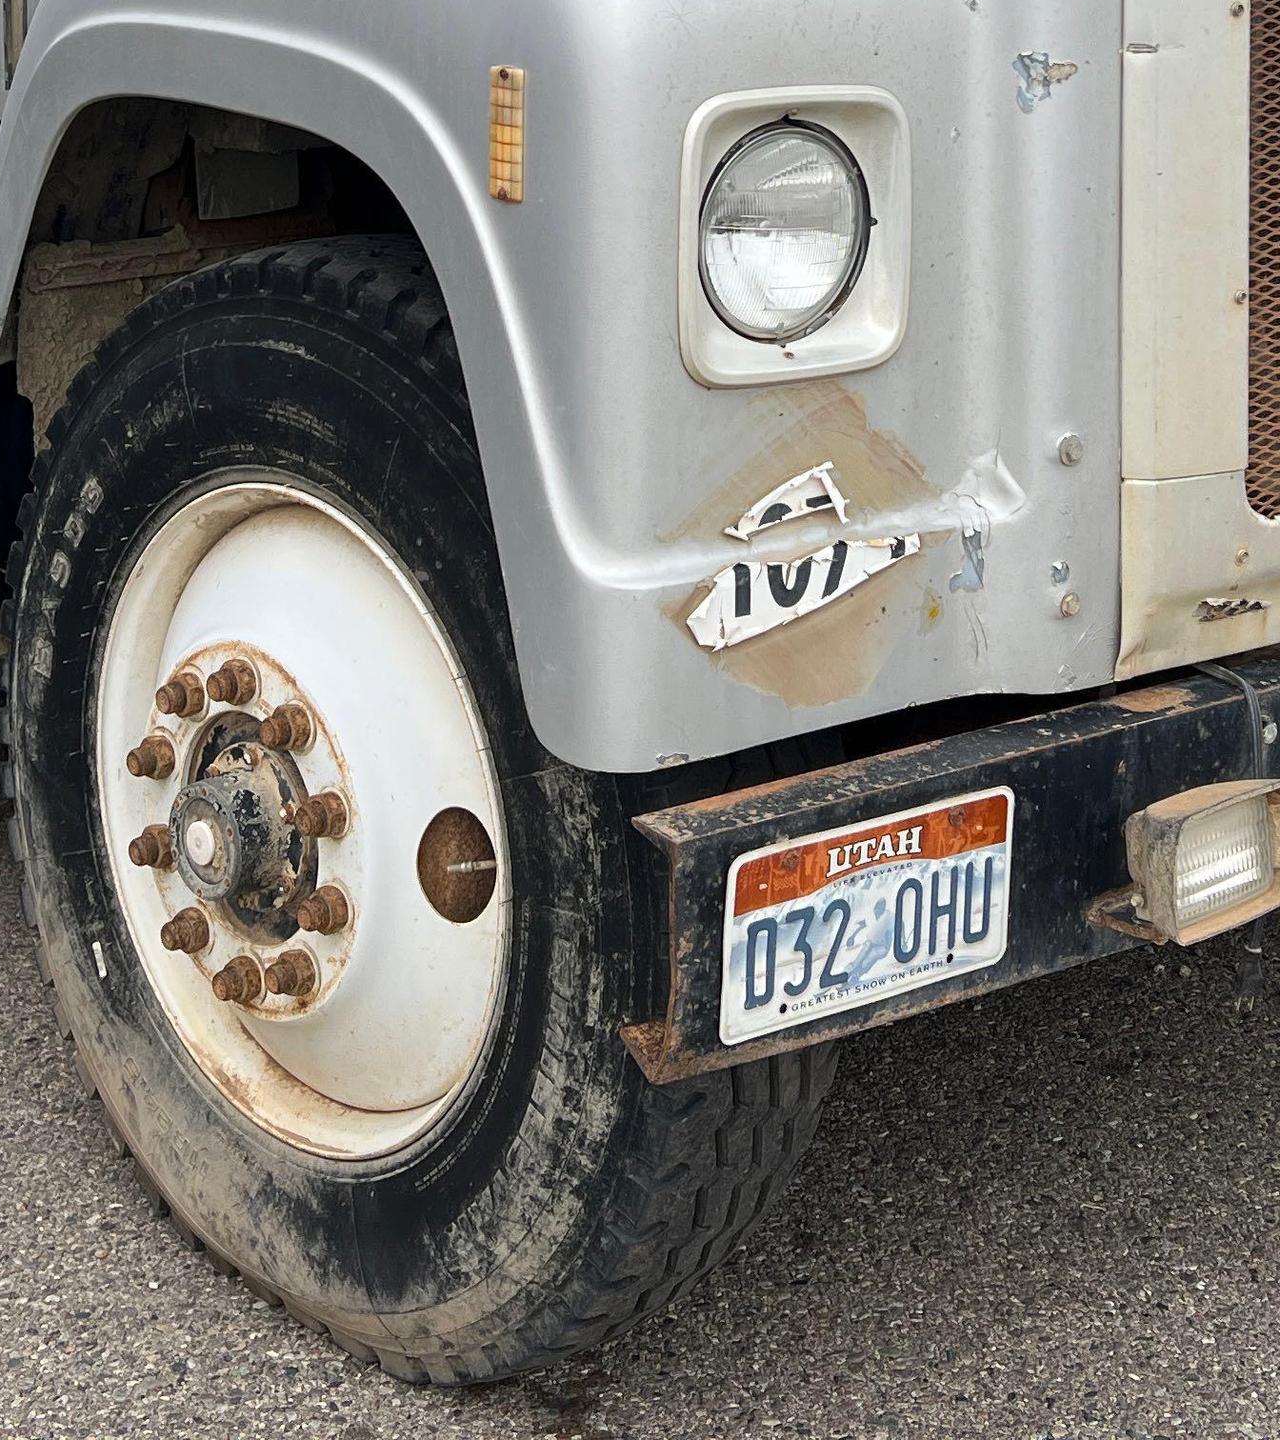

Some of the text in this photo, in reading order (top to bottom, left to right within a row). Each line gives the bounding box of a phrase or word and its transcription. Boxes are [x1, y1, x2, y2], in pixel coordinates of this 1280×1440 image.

[826, 825, 923, 879] UTAH
[744, 899, 851, 1011] D32
[791, 959, 944, 1012] GREATEST SNOW ON EARTH
